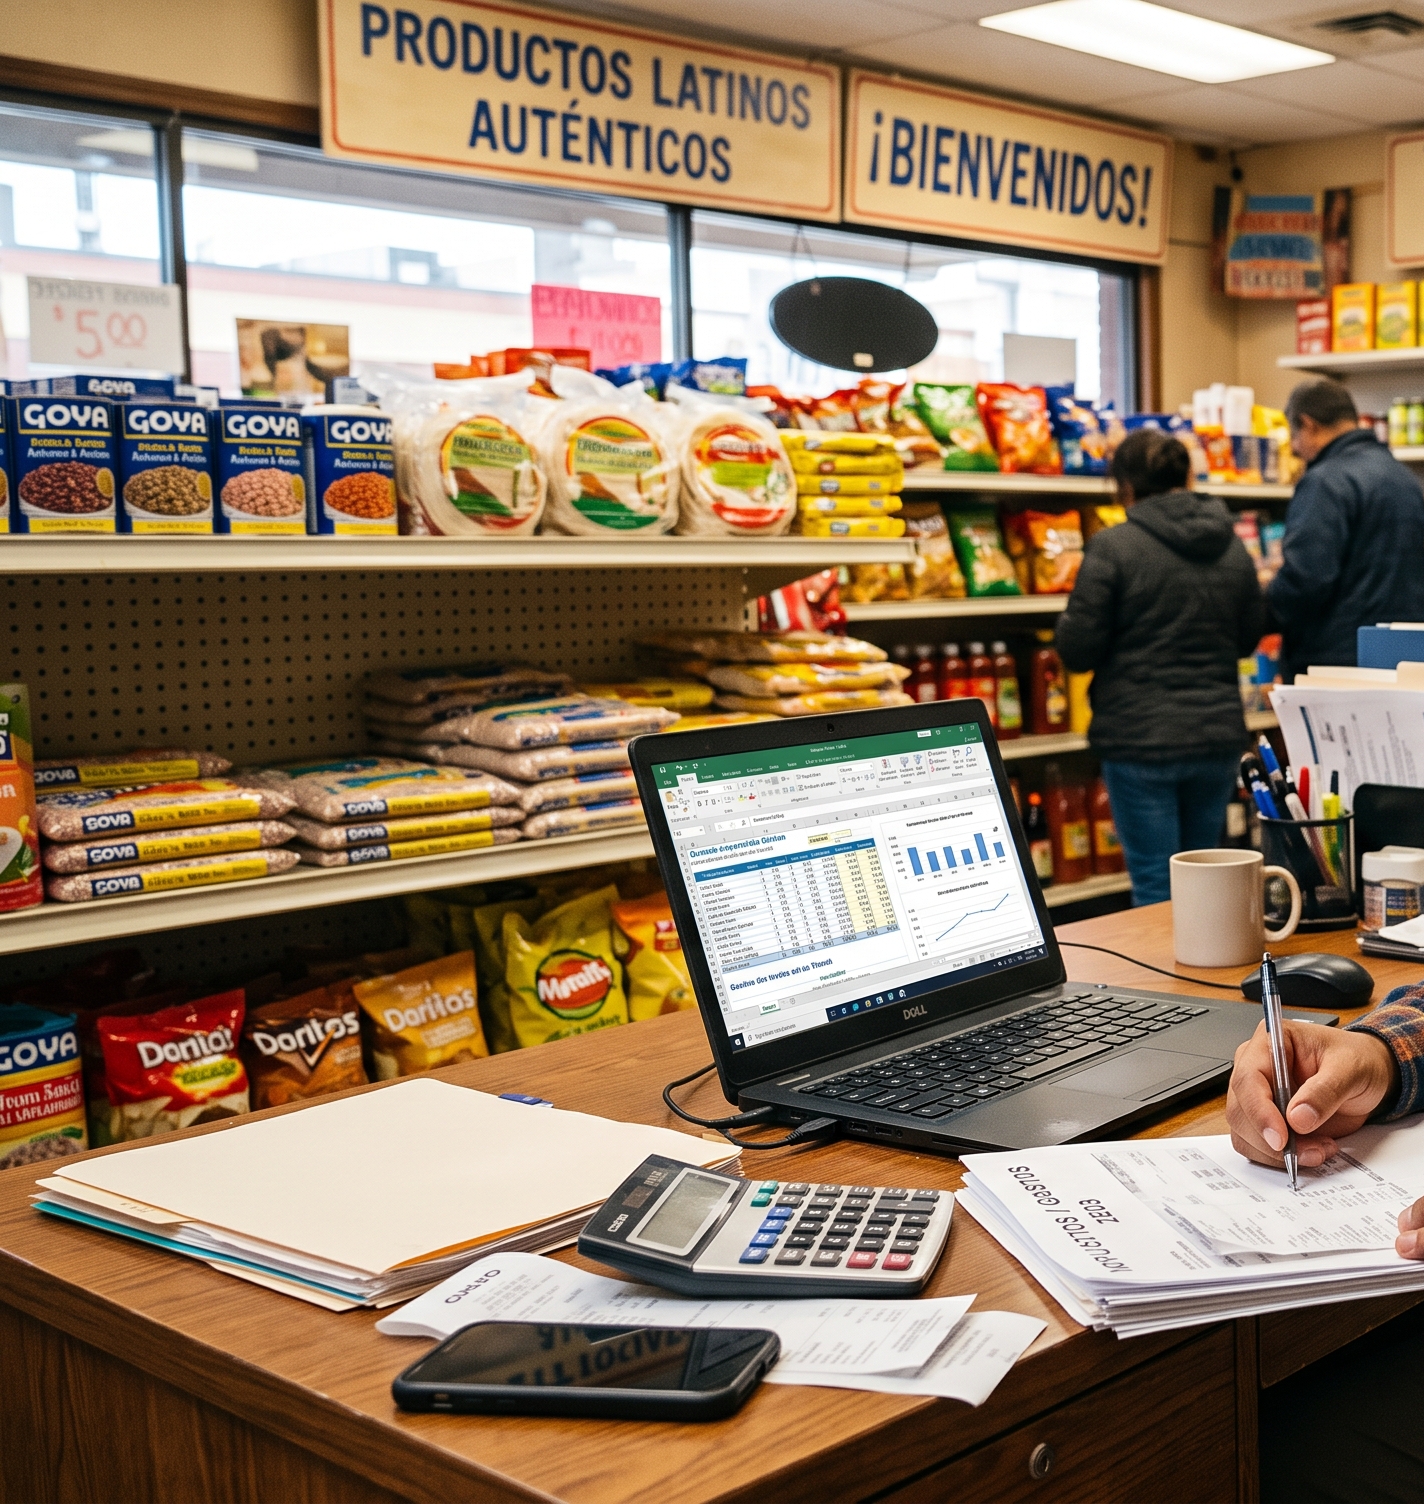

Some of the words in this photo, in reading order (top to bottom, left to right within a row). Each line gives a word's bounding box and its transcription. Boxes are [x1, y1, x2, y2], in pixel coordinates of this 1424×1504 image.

[360, 2, 632, 101] PRODUCTOS
[653, 57, 811, 131] LATINOS
[469, 99, 732, 184] AUTÉNTICOS
[868, 111, 1154, 228] ¡BIENVENIDOS!
[23, 403, 109, 429] GOYA
[128, 409, 206, 434] GOYA
[226, 414, 300, 438] GOYA
[253, 1011, 360, 1056] Doritos
[383, 987, 476, 1034] Doritos
